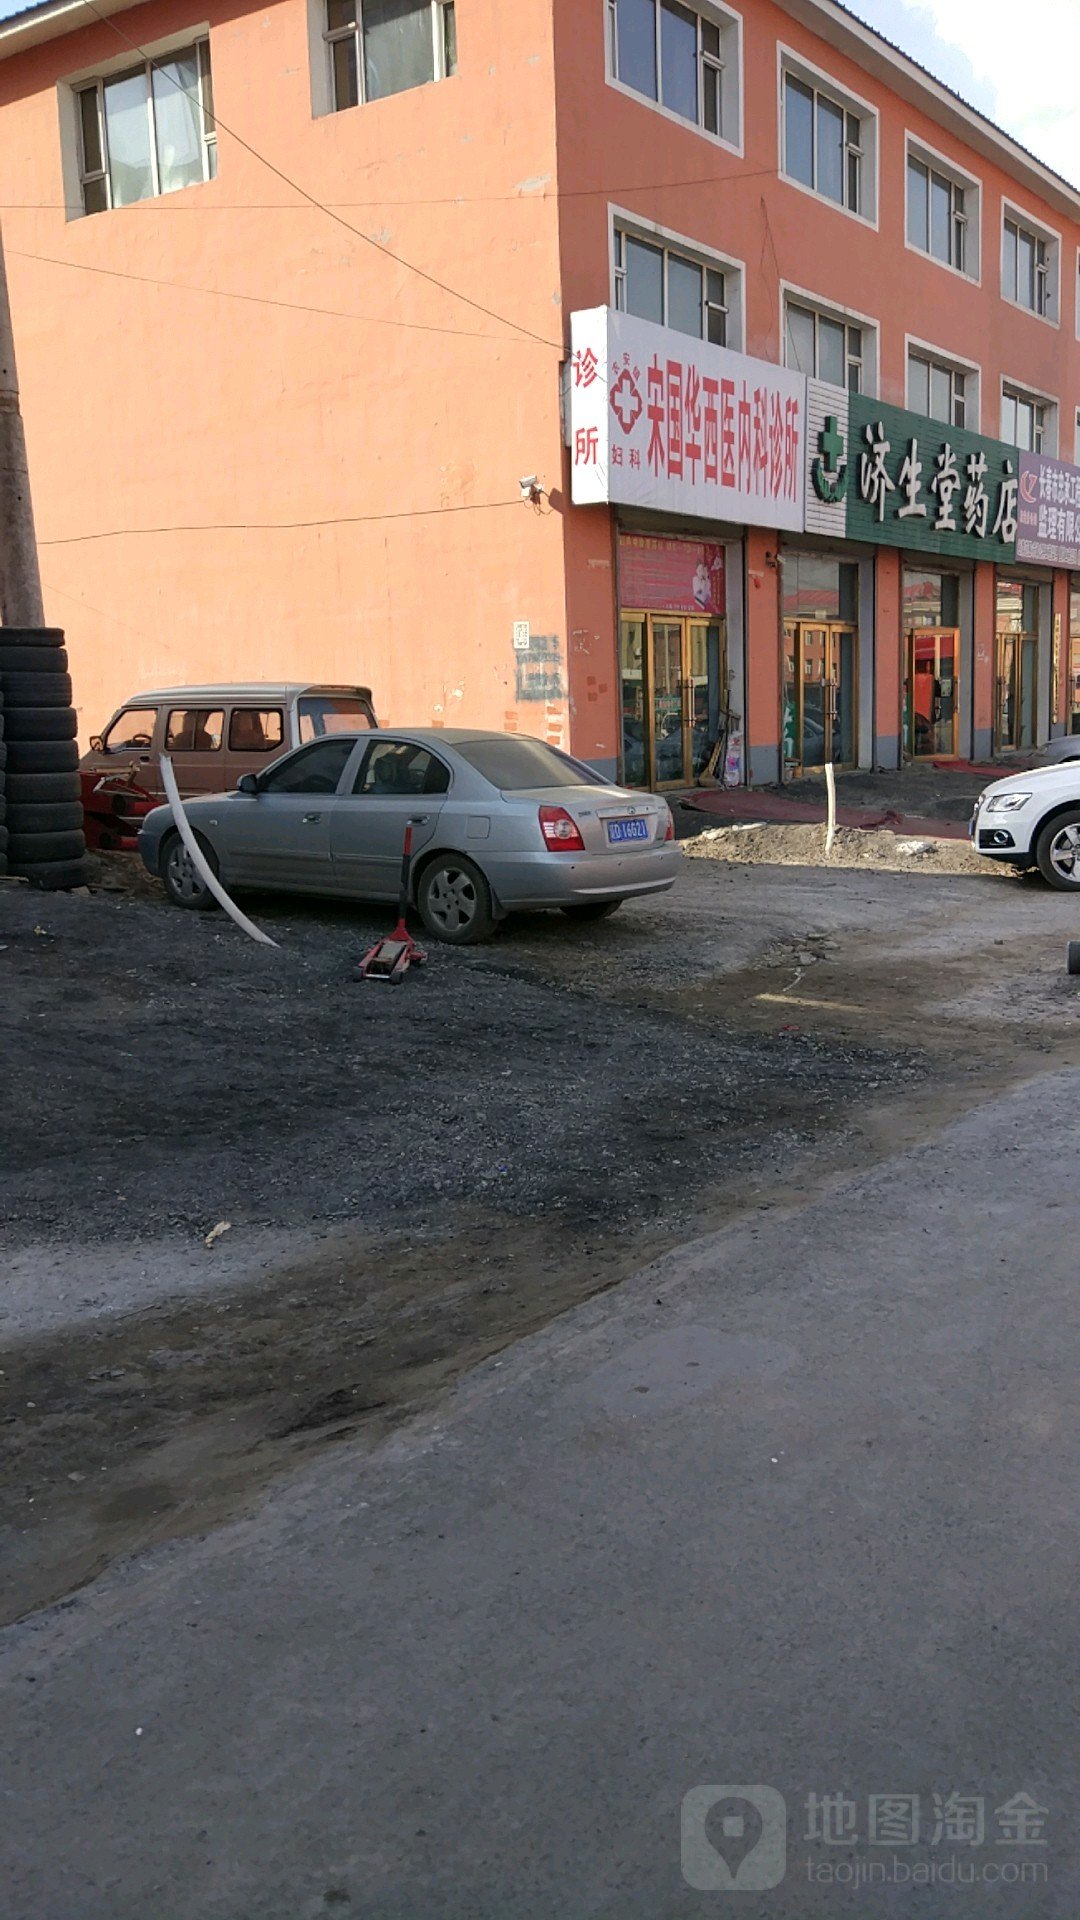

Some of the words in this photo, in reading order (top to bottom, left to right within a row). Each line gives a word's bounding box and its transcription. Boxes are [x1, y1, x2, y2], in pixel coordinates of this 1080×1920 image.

[572, 347, 599, 465] 诊所
[611, 444, 641, 471] 妇科
[646, 353, 799, 503] 宋国华西医内科诊所
[860, 421, 1018, 544] 济生堂药店
